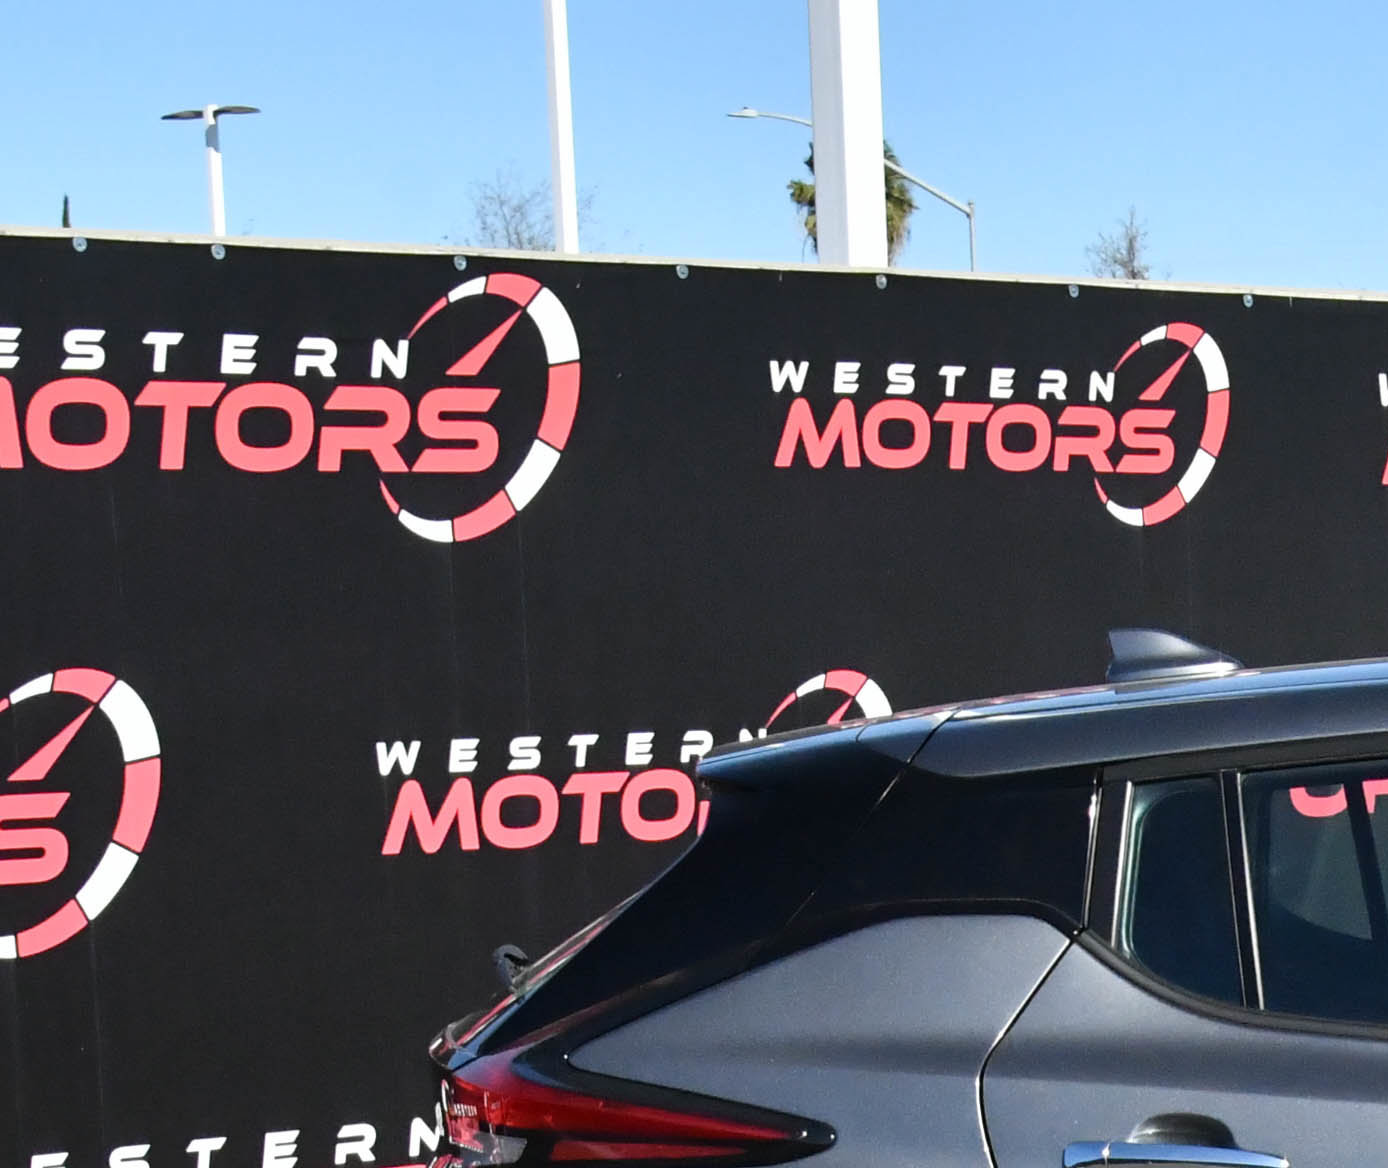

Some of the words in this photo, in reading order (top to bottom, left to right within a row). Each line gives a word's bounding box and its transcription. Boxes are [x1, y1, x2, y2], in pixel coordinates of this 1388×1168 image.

[769, 360, 1116, 404] WESTERN
[0, 376, 501, 473] OTORS
[774, 397, 1176, 474] MOTORS
[381, 768, 710, 855] MOTO
